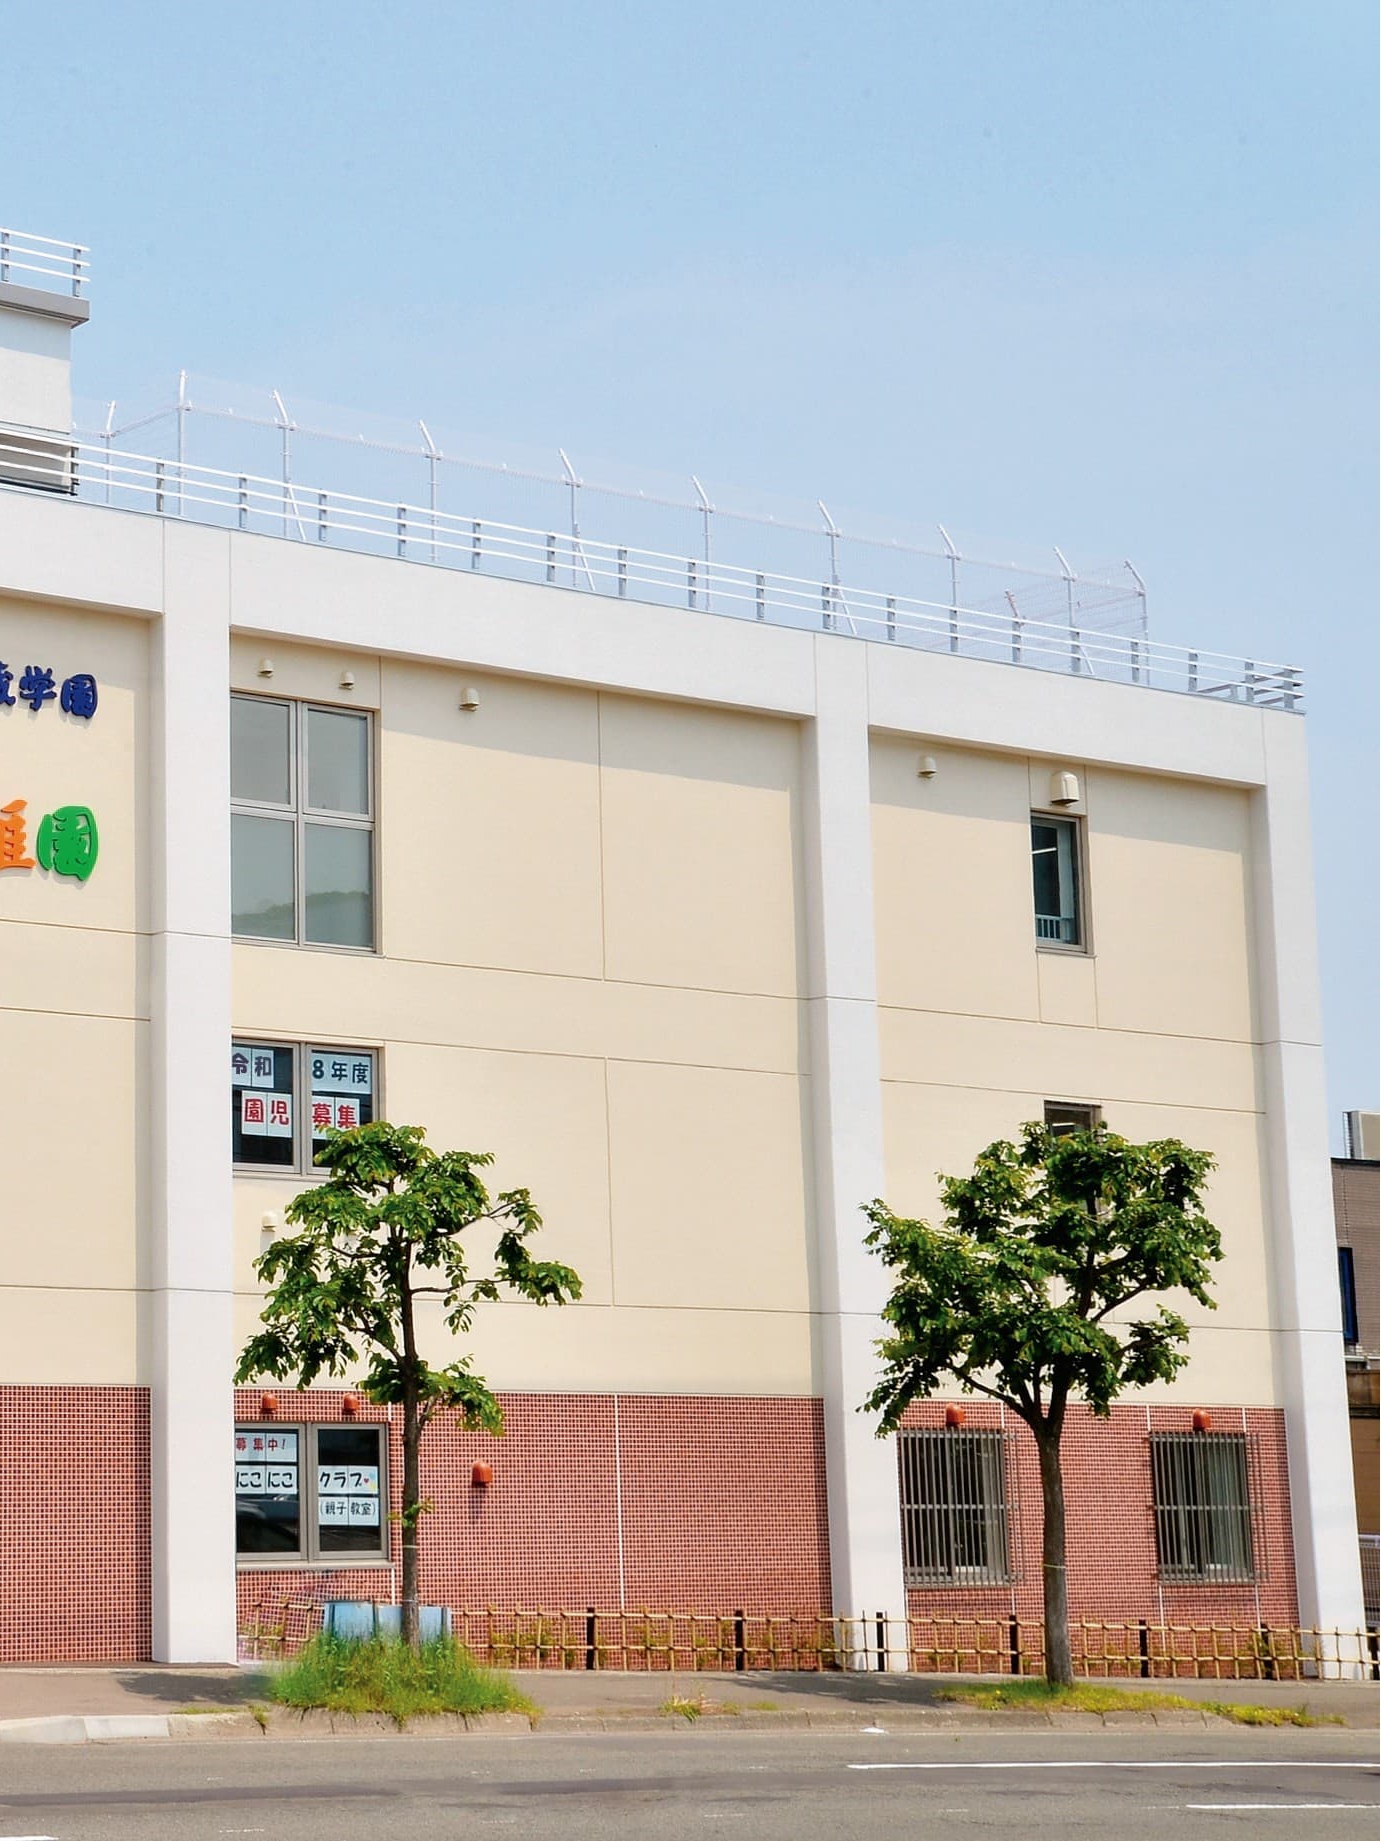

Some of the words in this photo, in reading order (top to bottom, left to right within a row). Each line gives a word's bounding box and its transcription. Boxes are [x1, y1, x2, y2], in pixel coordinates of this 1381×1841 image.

[232, 1053, 272, 1077] 令和
[312, 1060, 369, 1084] 8年度
[244, 1098, 289, 1125] 園児
[236, 1471, 293, 1488] にこにこ
